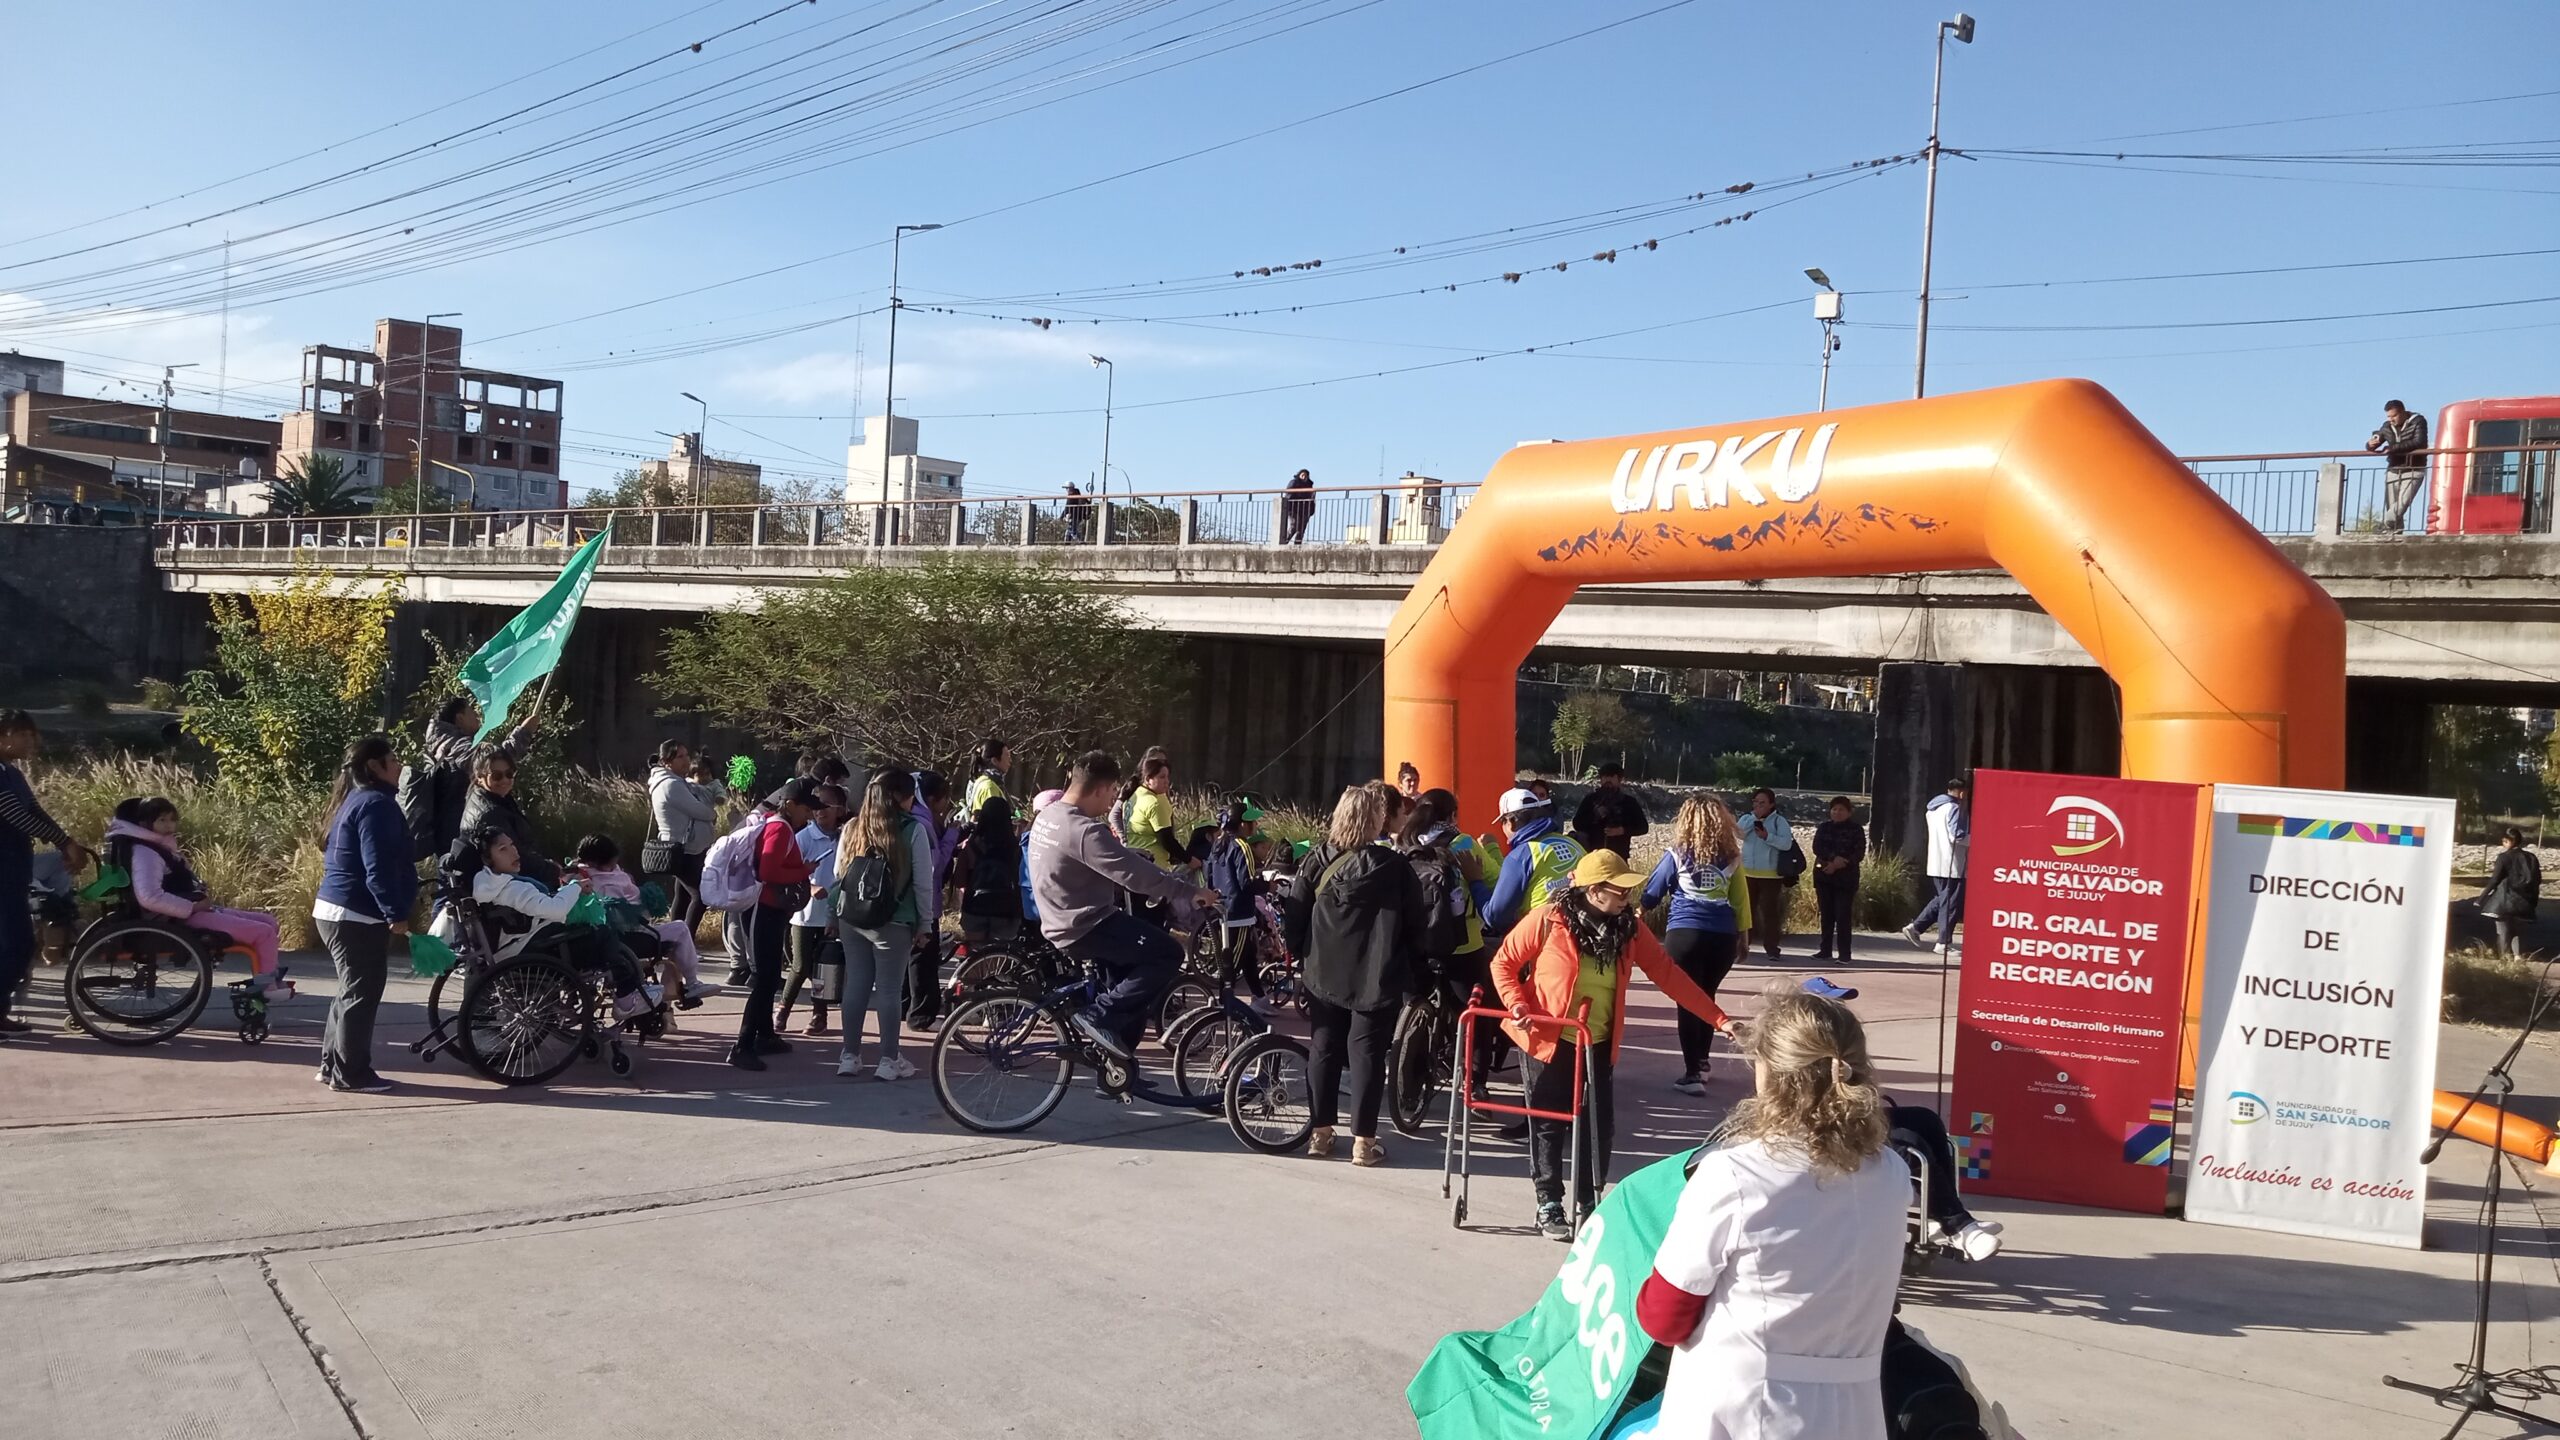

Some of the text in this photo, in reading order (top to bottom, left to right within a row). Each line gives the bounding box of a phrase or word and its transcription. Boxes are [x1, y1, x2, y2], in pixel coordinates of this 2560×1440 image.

[1608, 422, 1840, 515] URKU
[1993, 867, 2163, 896] SAN SALVADOR
[2019, 859, 2139, 877] MUNICIPALIDAD DE
[2047, 889, 2106, 902] DE JUJUY
[2249, 873, 2404, 906] DIRECCIÓN
[1992, 909, 2159, 942] DIR. GRAL. DE
[2304, 929, 2340, 951] DE
[2002, 936, 2145, 967] DEPORTE Y
[1989, 961, 2153, 995] RECREACIÓN
[2244, 974, 2394, 1008] INCLUSIÓN
[1971, 1009, 2165, 1038] Secretaría de Desarrollo Humano
[2034, 1047, 2060, 1056] General
[2070, 1051, 2097, 1060] Deporte
[2103, 1055, 2140, 1065] Recreación
[2240, 1025, 2391, 1060] Y DEPORTE
[2276, 1101, 2344, 1114] MUNICIPALIDAD
[2276, 1108, 2391, 1130] SAN SALVADOR
[2275, 1119, 2314, 1129] DE JUJUY
[2199, 1154, 2415, 1201] Inclusión es acción
